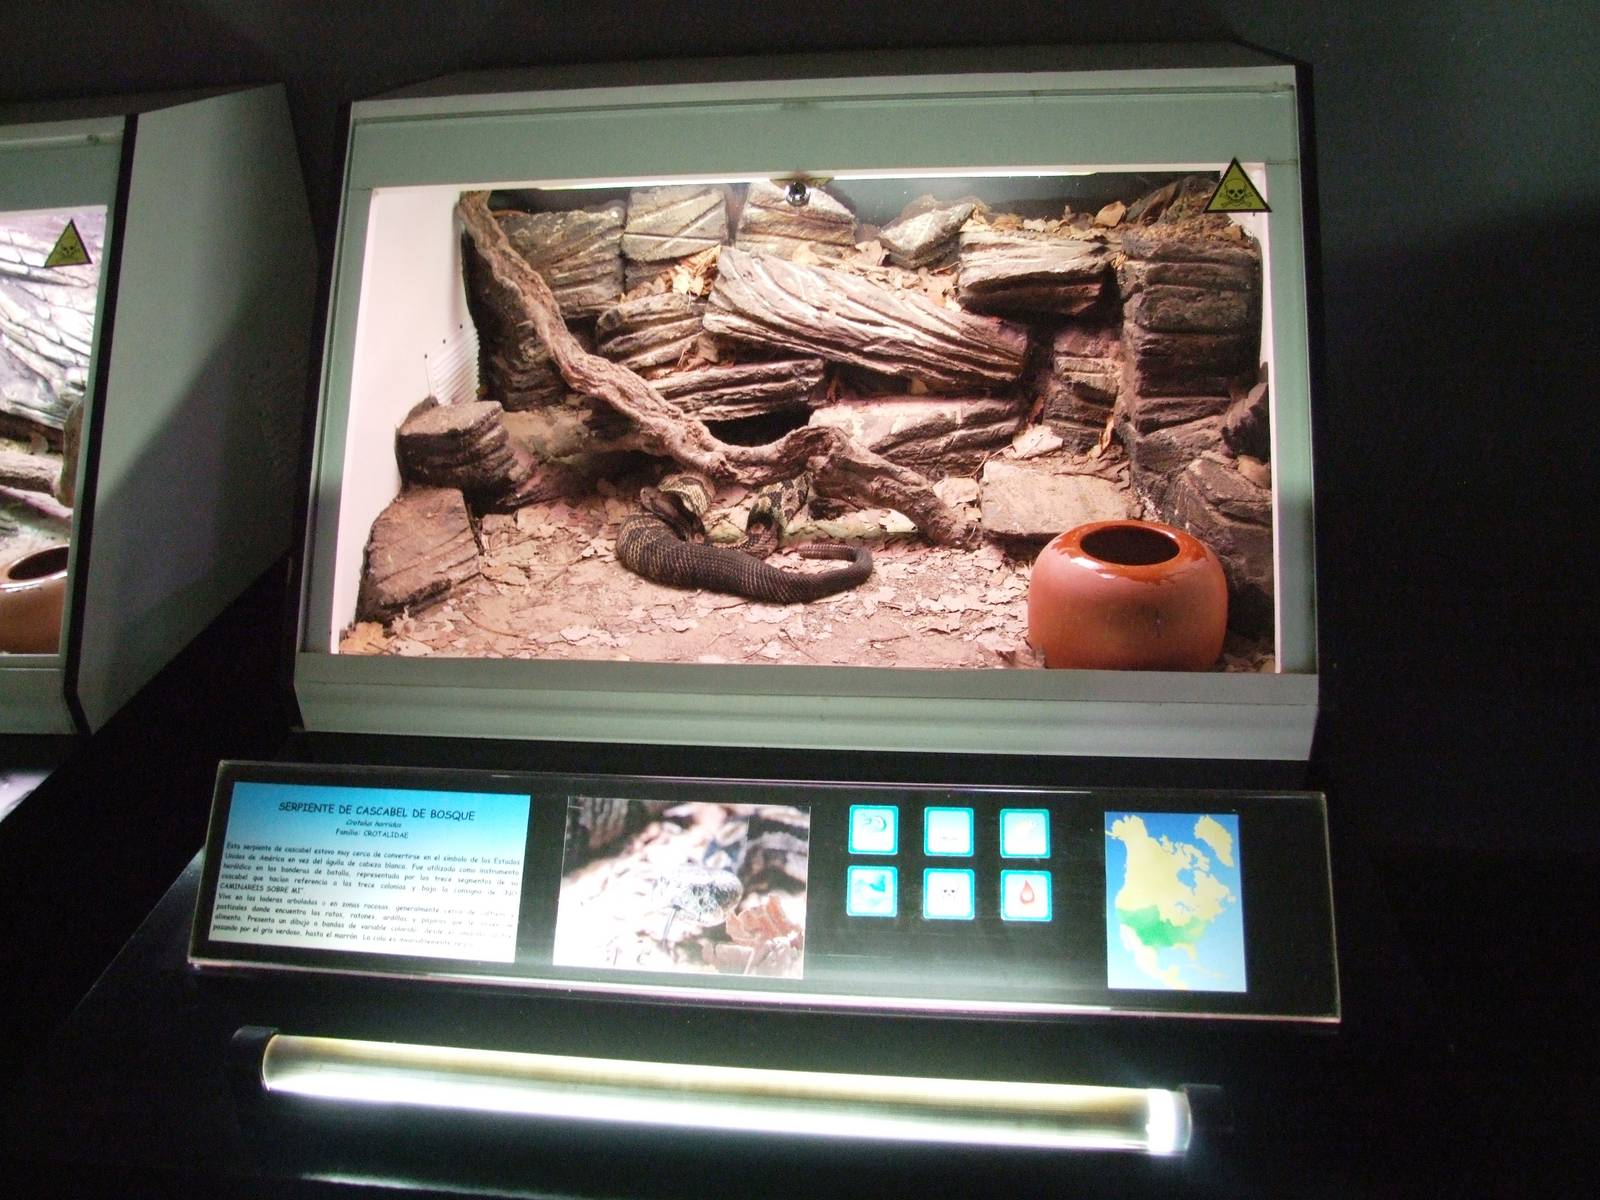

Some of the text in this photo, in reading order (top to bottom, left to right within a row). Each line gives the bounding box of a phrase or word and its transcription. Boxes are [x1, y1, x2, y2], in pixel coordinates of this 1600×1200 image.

[278, 802, 476, 822] SERPIENTE DE CASCABEL DE BOSQUE
[363, 829, 409, 839] CROTALIDAE
[226, 842, 241, 850] Esta
[284, 845, 312, 854] cascabel
